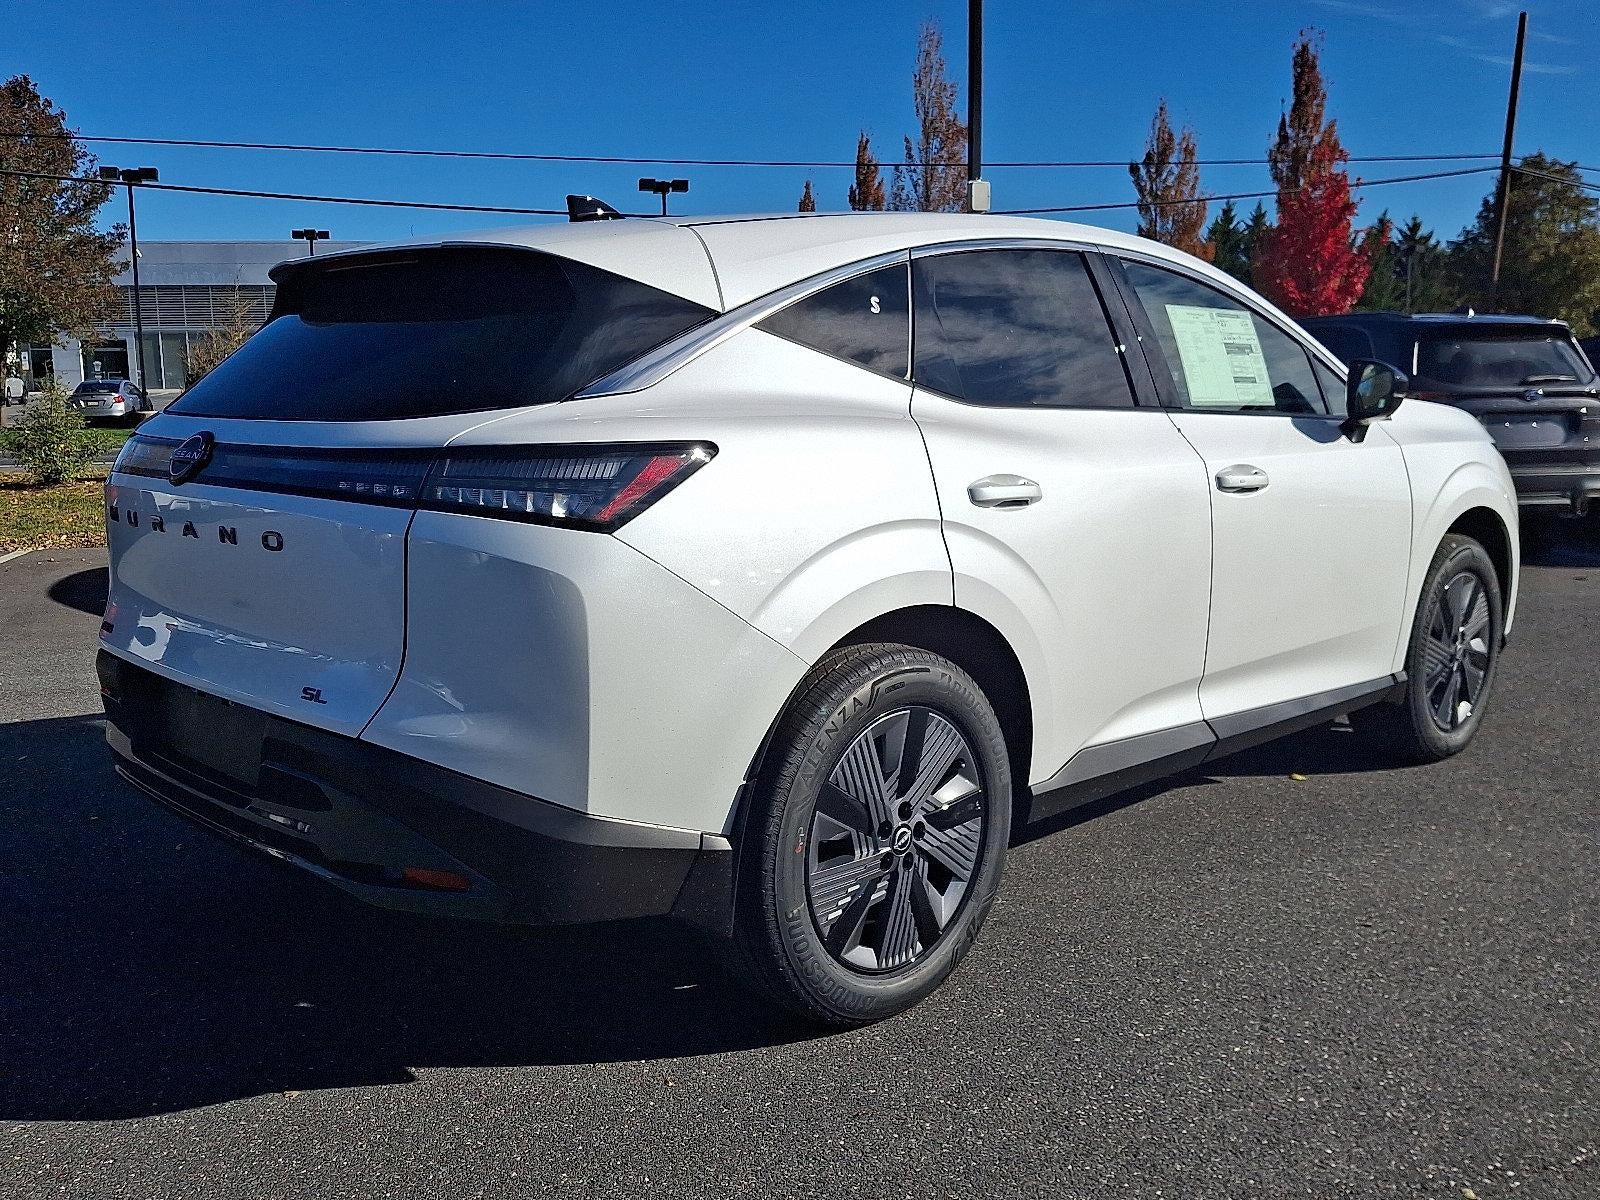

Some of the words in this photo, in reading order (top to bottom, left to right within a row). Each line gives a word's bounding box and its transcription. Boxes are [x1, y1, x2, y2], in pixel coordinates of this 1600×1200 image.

[870, 295, 881, 314] S
[301, 686, 328, 705] SL
[799, 696, 864, 784] ALENZA
